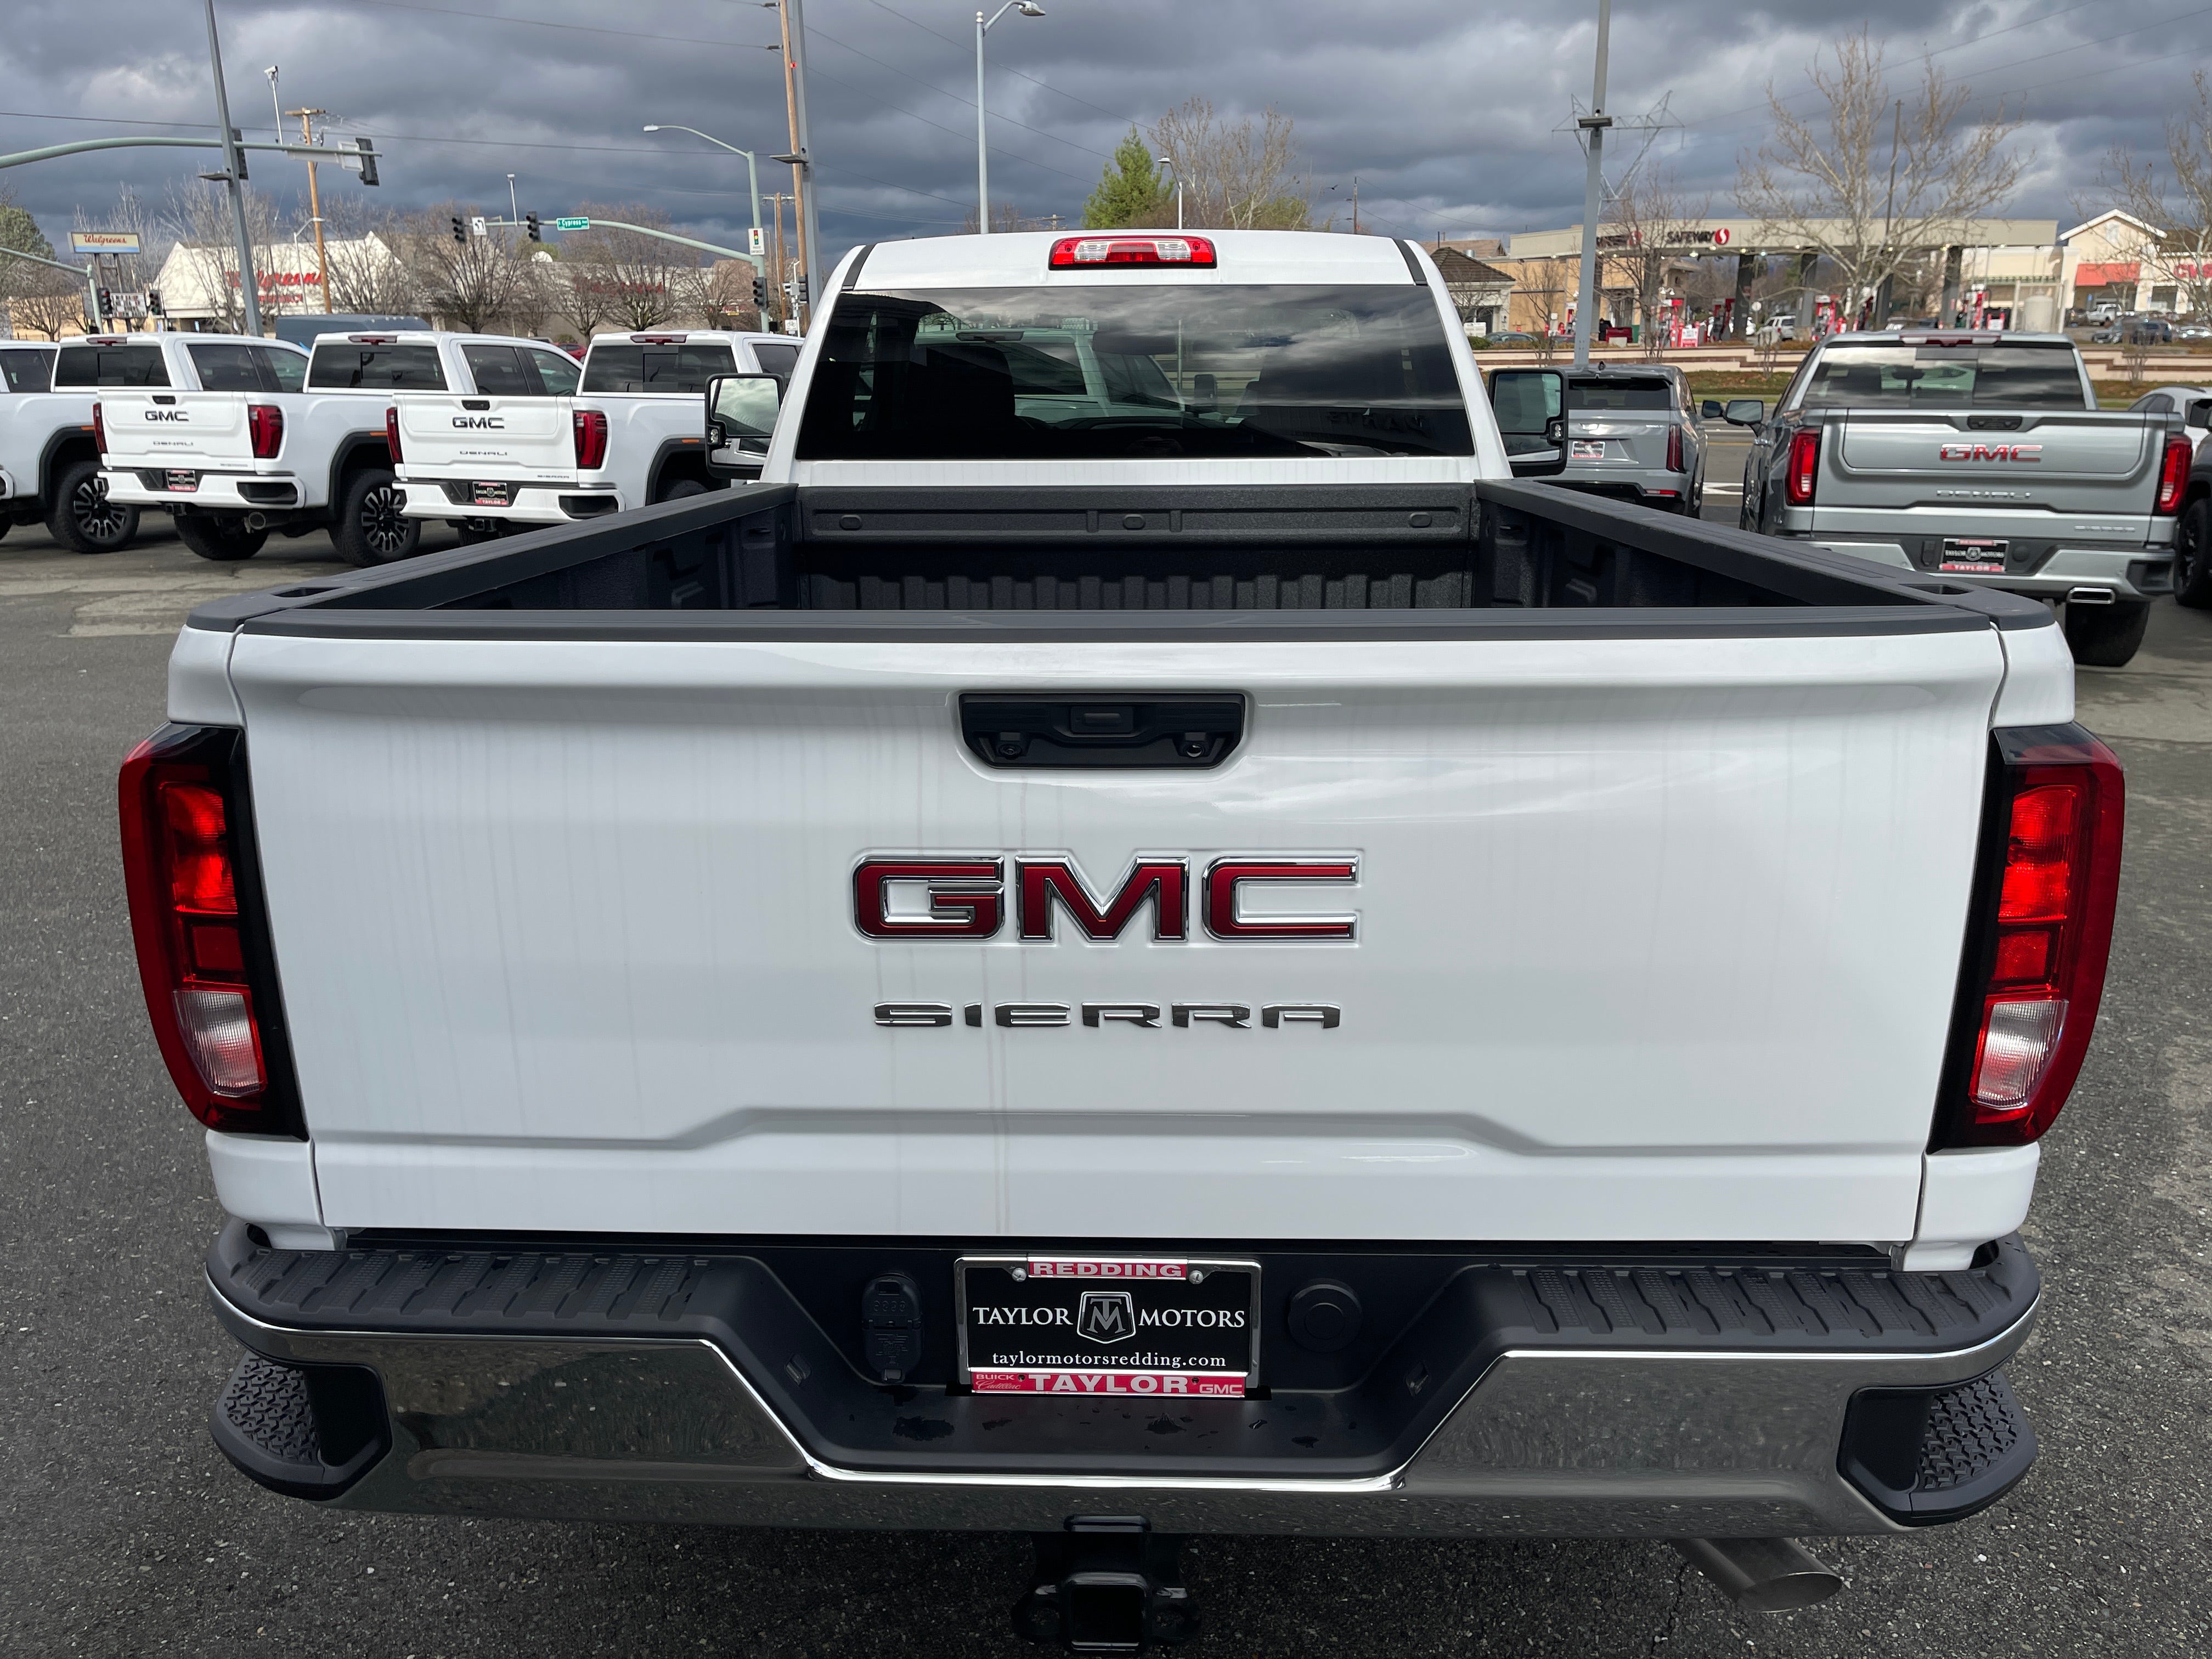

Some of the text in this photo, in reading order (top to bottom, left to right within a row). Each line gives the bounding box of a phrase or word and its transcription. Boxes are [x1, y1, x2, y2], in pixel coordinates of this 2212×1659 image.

[83, 234, 127, 246] Walgreens
[1667, 231, 1715, 244] SAFEWAY
[225, 269, 324, 291] Wlgreen
[145, 410, 189, 422] GMC
[452, 417, 505, 428] GMC
[1940, 443, 2043, 462] GMC
[1937, 490, 2031, 500] DENALI
[853, 851, 1362, 945] GMC
[874, 1002, 1340, 1028] SIERRA
[1034, 1263, 1182, 1277] REDDING
[972, 1307, 1245, 1328] TAYLOR MOTORS
[992, 1351, 1226, 1368] taylormotorsredding.com
[975, 1380, 1022, 1390] Cadillac
[1029, 1375, 1188, 1393] TAYLOR
[1199, 1384, 1243, 1394] GMC
